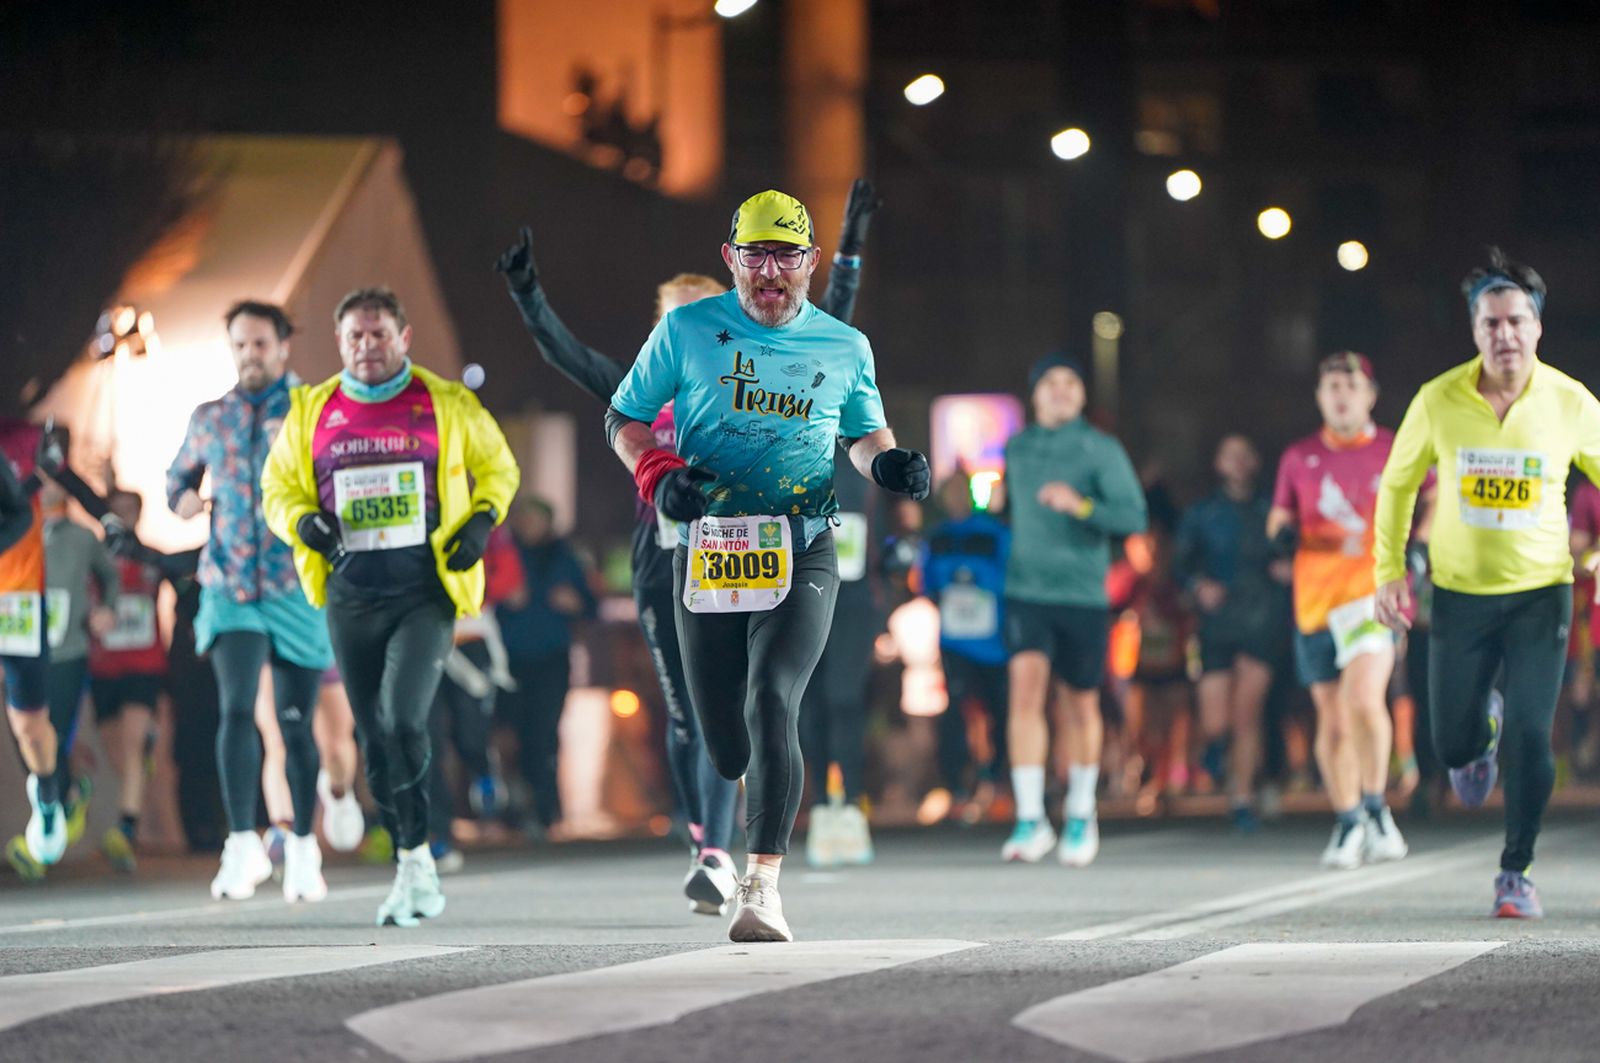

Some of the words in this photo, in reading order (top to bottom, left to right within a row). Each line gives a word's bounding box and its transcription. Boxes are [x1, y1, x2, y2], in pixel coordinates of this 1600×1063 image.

[732, 351, 755, 377] LA
[1473, 478, 1530, 501] 4526
[352, 495, 409, 522] 6535
[701, 539, 718, 550] SAN
[710, 527, 734, 539] NOCHE
[736, 527, 749, 538] DE
[700, 551, 780, 580] 13009
